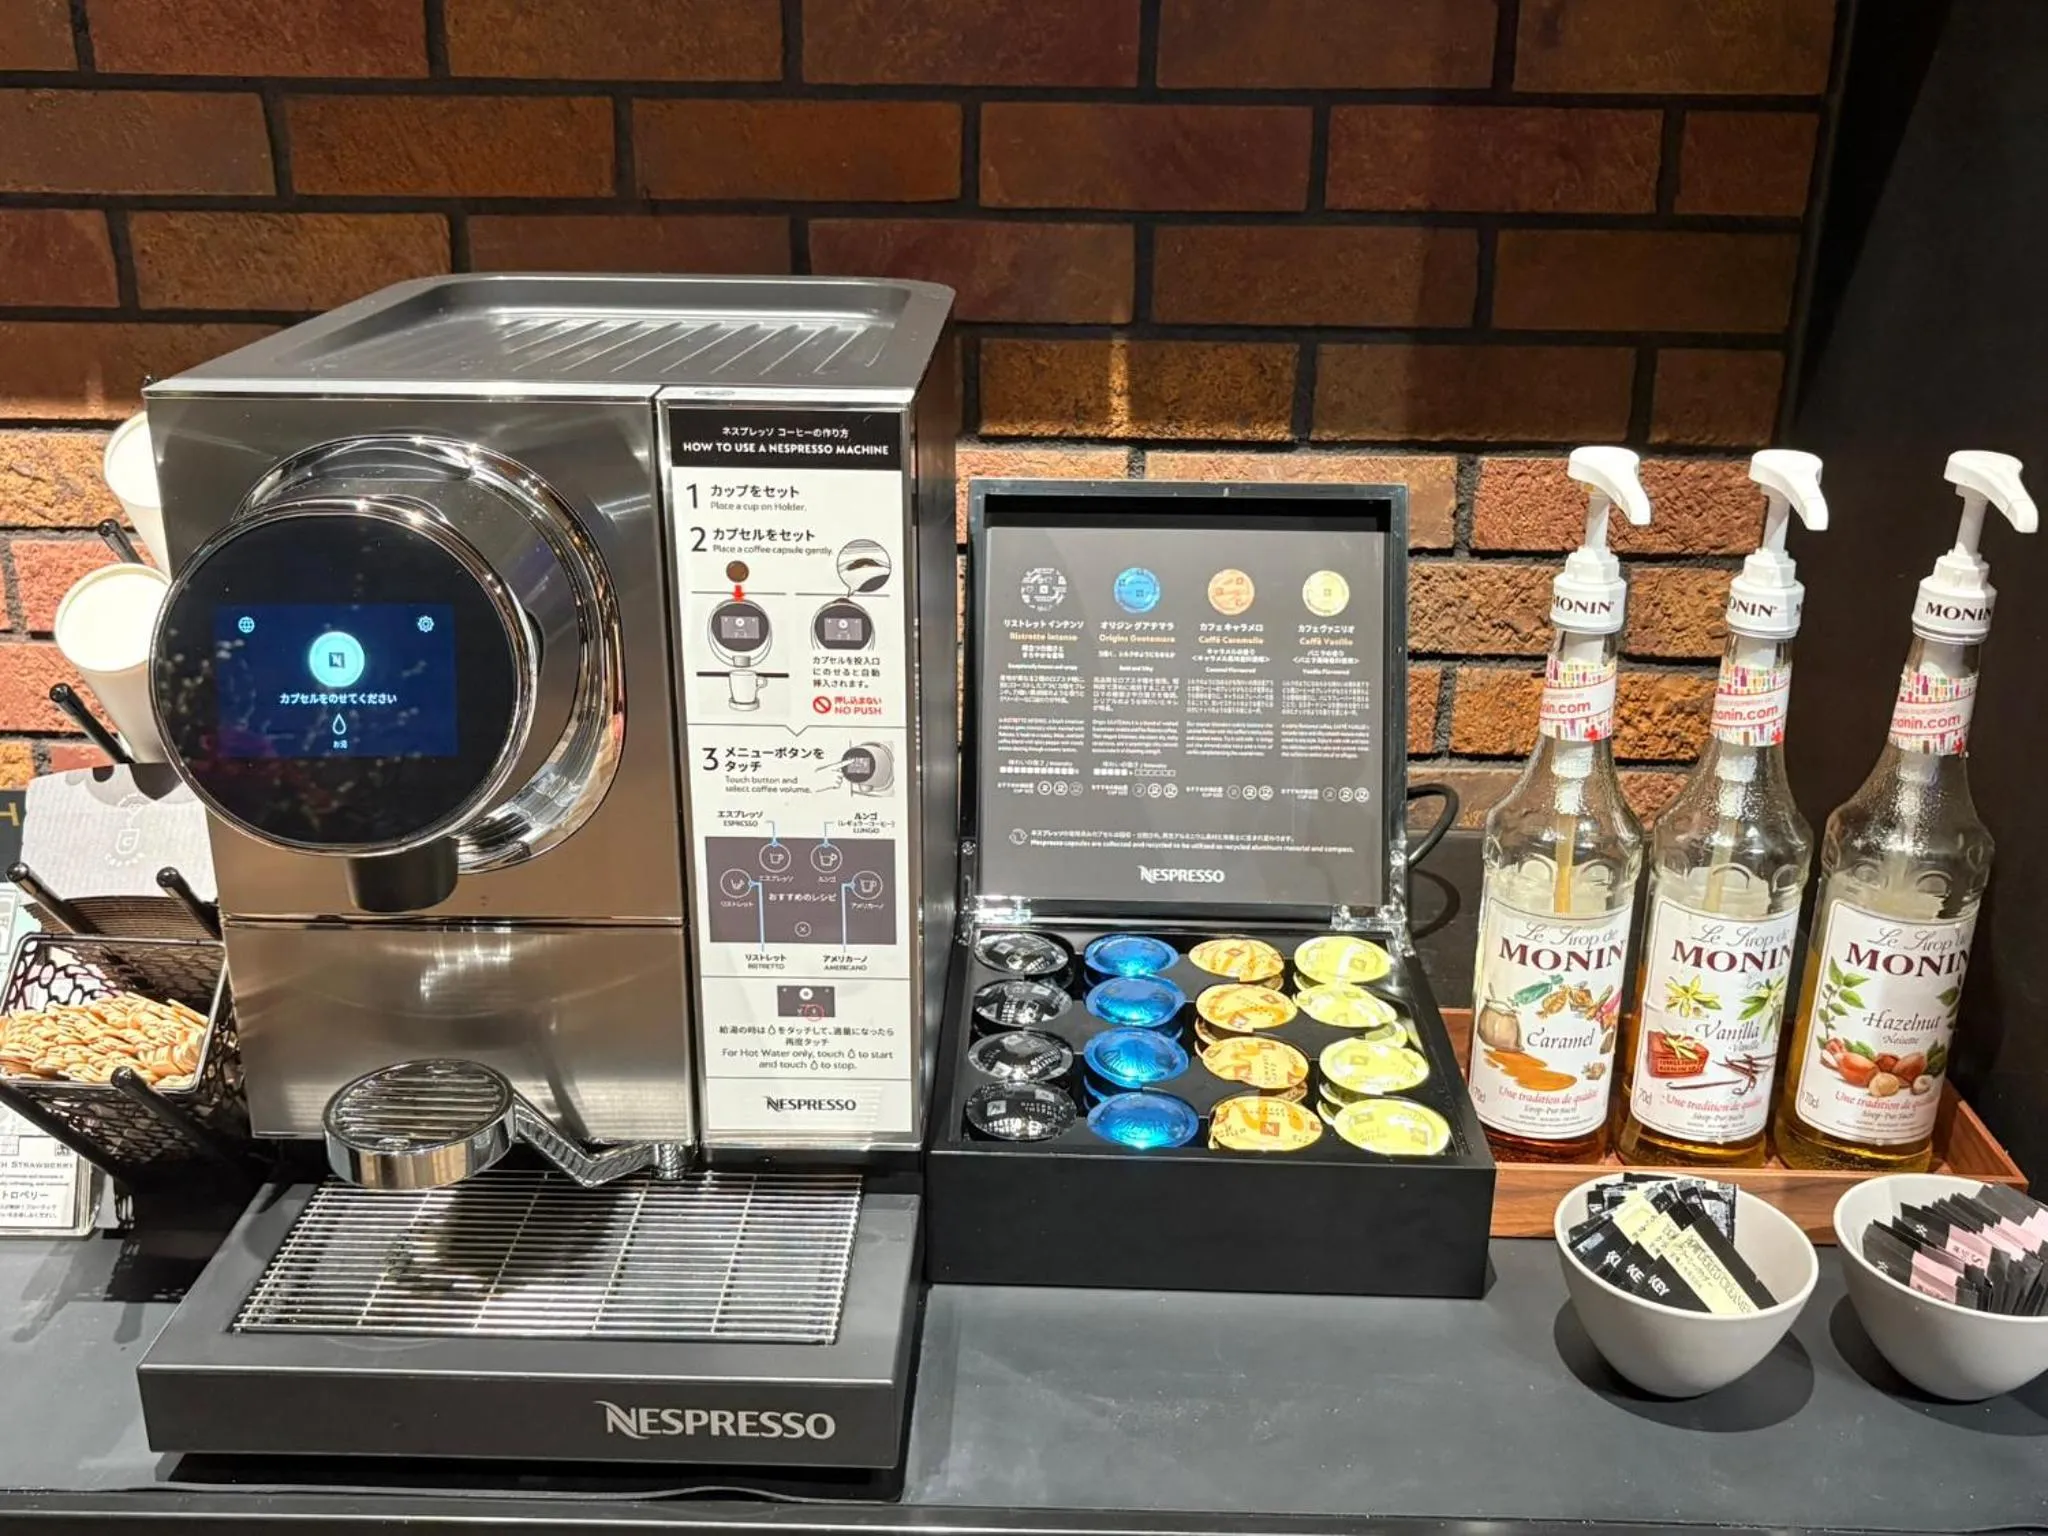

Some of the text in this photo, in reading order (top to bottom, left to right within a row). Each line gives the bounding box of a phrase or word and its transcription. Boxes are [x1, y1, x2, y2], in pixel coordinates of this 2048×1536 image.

[683, 442, 890, 456] HOW TO USE A NESPRESSO MACHINE
[686, 483, 698, 509] 1
[710, 484, 800, 499] カップをセット
[710, 501, 734, 511] Place
[736, 503, 742, 511] a
[743, 503, 759, 513] cup
[761, 503, 772, 511] on
[690, 527, 707, 552] 2
[713, 528, 816, 542] カプセルをセット
[713, 544, 735, 553] Place
[737, 546, 743, 554] a
[744, 544, 770, 555] coffee
[772, 546, 803, 557] capsule
[279, 692, 398, 705] カプセルをのせてください
[834, 706, 882, 716] NO PUSH
[701, 748, 719, 771] 3
[725, 747, 825, 760] メニューボタンを
[724, 761, 762, 773] タッチ
[725, 775, 798, 785] Touch button and
[725, 785, 750, 794] select
[752, 785, 778, 794] coffee
[1137, 865, 1225, 883] NESPRESSO
[1499, 937, 1625, 972] MONIN
[1863, 1009, 1943, 1032] Hazelnut
[1695, 1016, 1760, 1041] Vanilla
[1527, 1027, 1596, 1049] Caramel
[721, 1049, 894, 1060] For Hot Water only, touch to start
[759, 1061, 857, 1072] and touch to stop.
[763, 1095, 857, 1113] NESPRESSO
[593, 1400, 836, 1440] NESPRESSO
